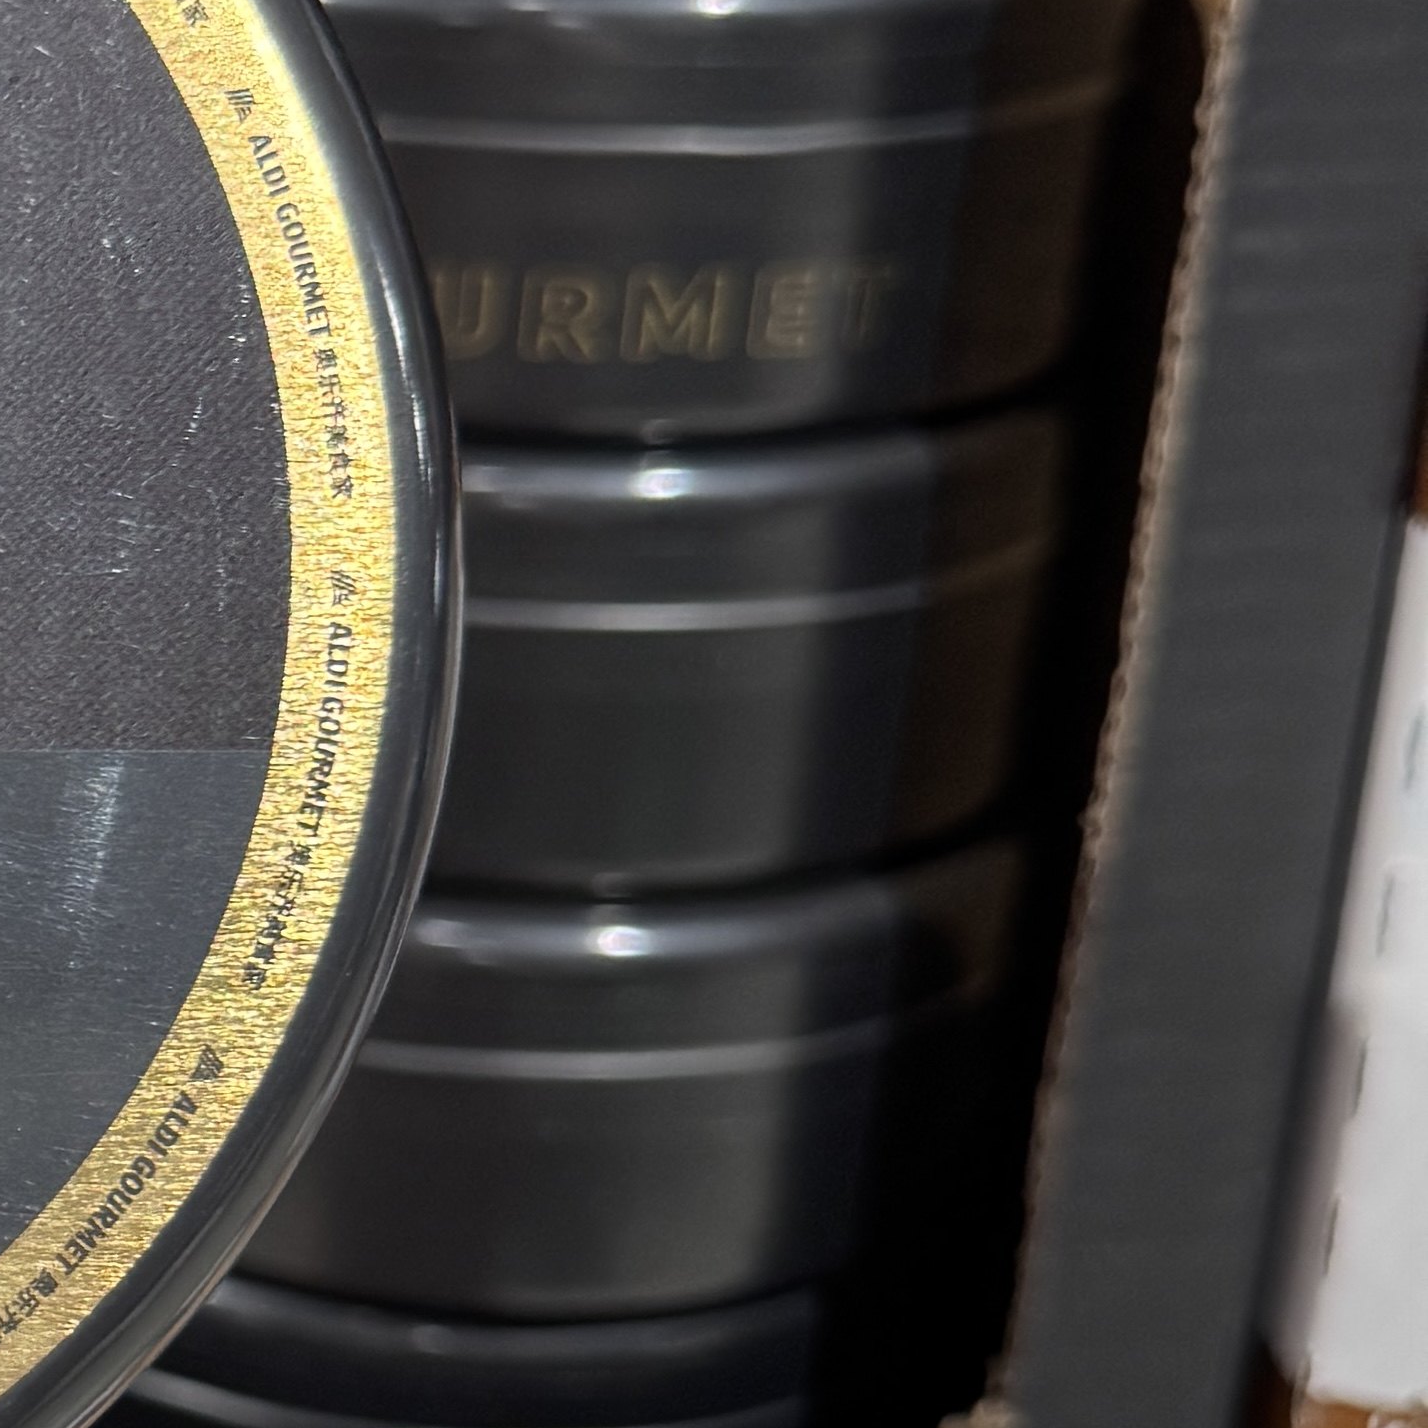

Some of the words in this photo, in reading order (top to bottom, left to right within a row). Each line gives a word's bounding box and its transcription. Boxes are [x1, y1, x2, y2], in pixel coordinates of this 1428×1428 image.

[247, 134, 290, 198] ALDI
[276, 202, 333, 338] GOURMET
[428, 260, 894, 363] URMET
[324, 621, 353, 688] ALDI
[297, 695, 343, 839] GOURMET
[146, 1090, 199, 1158] ALDI
[55, 1155, 157, 1276] GOURMET
